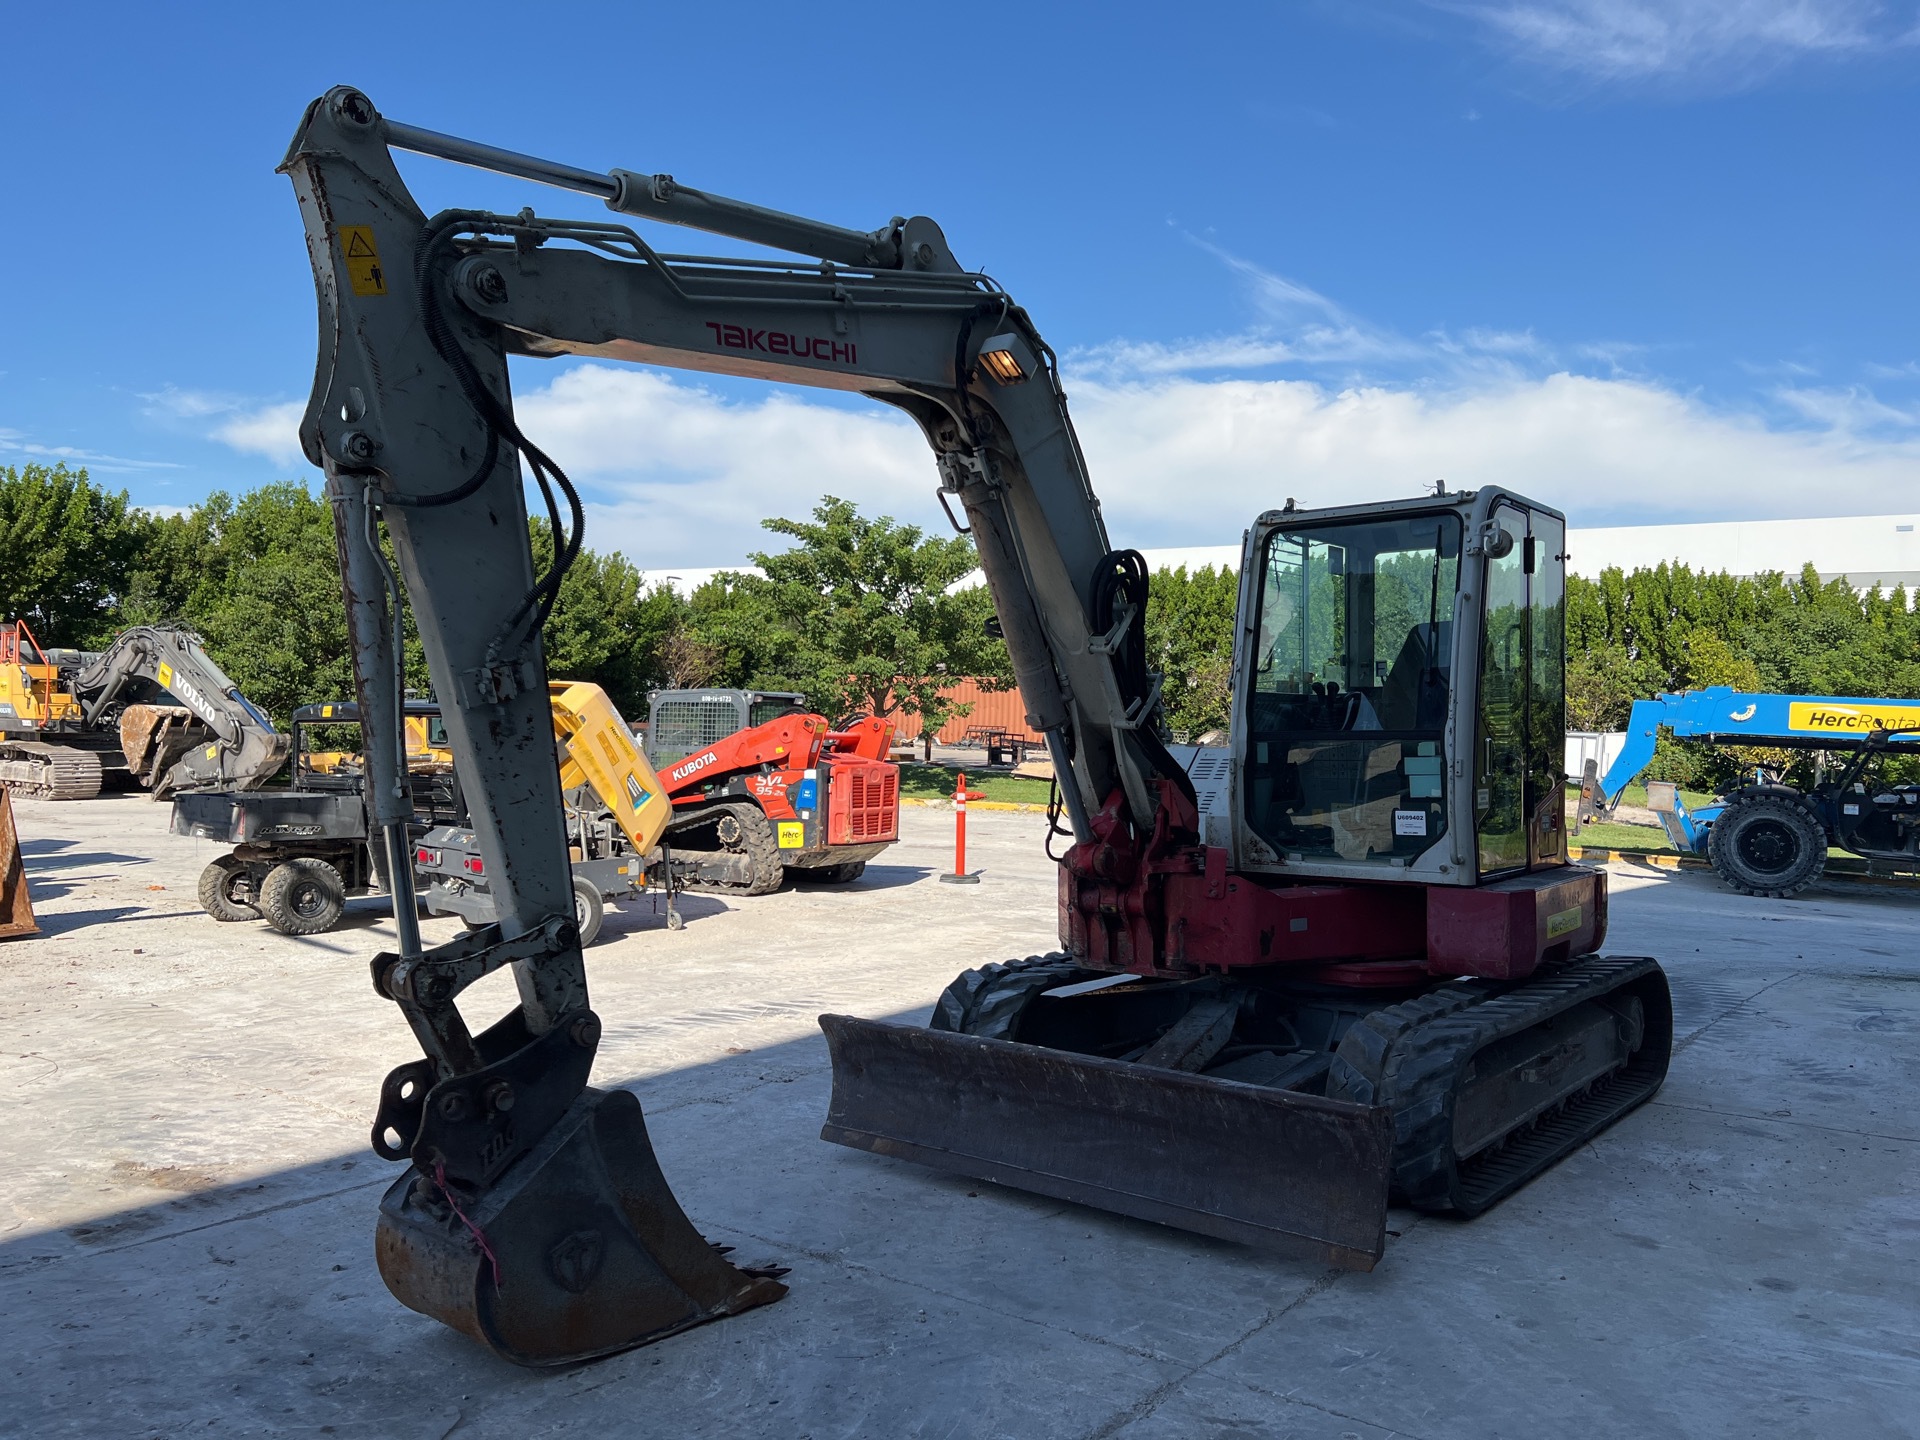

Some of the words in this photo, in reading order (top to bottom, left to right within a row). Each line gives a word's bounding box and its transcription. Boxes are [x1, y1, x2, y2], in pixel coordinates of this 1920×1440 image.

[175, 671, 216, 722] VOLVO
[1808, 712, 1920, 730] HercRenta
[672, 751, 718, 782] KUBOTA
[755, 774, 788, 787] SVL
[260, 826, 321, 835] RANGER
[782, 831, 799, 840] Herc
